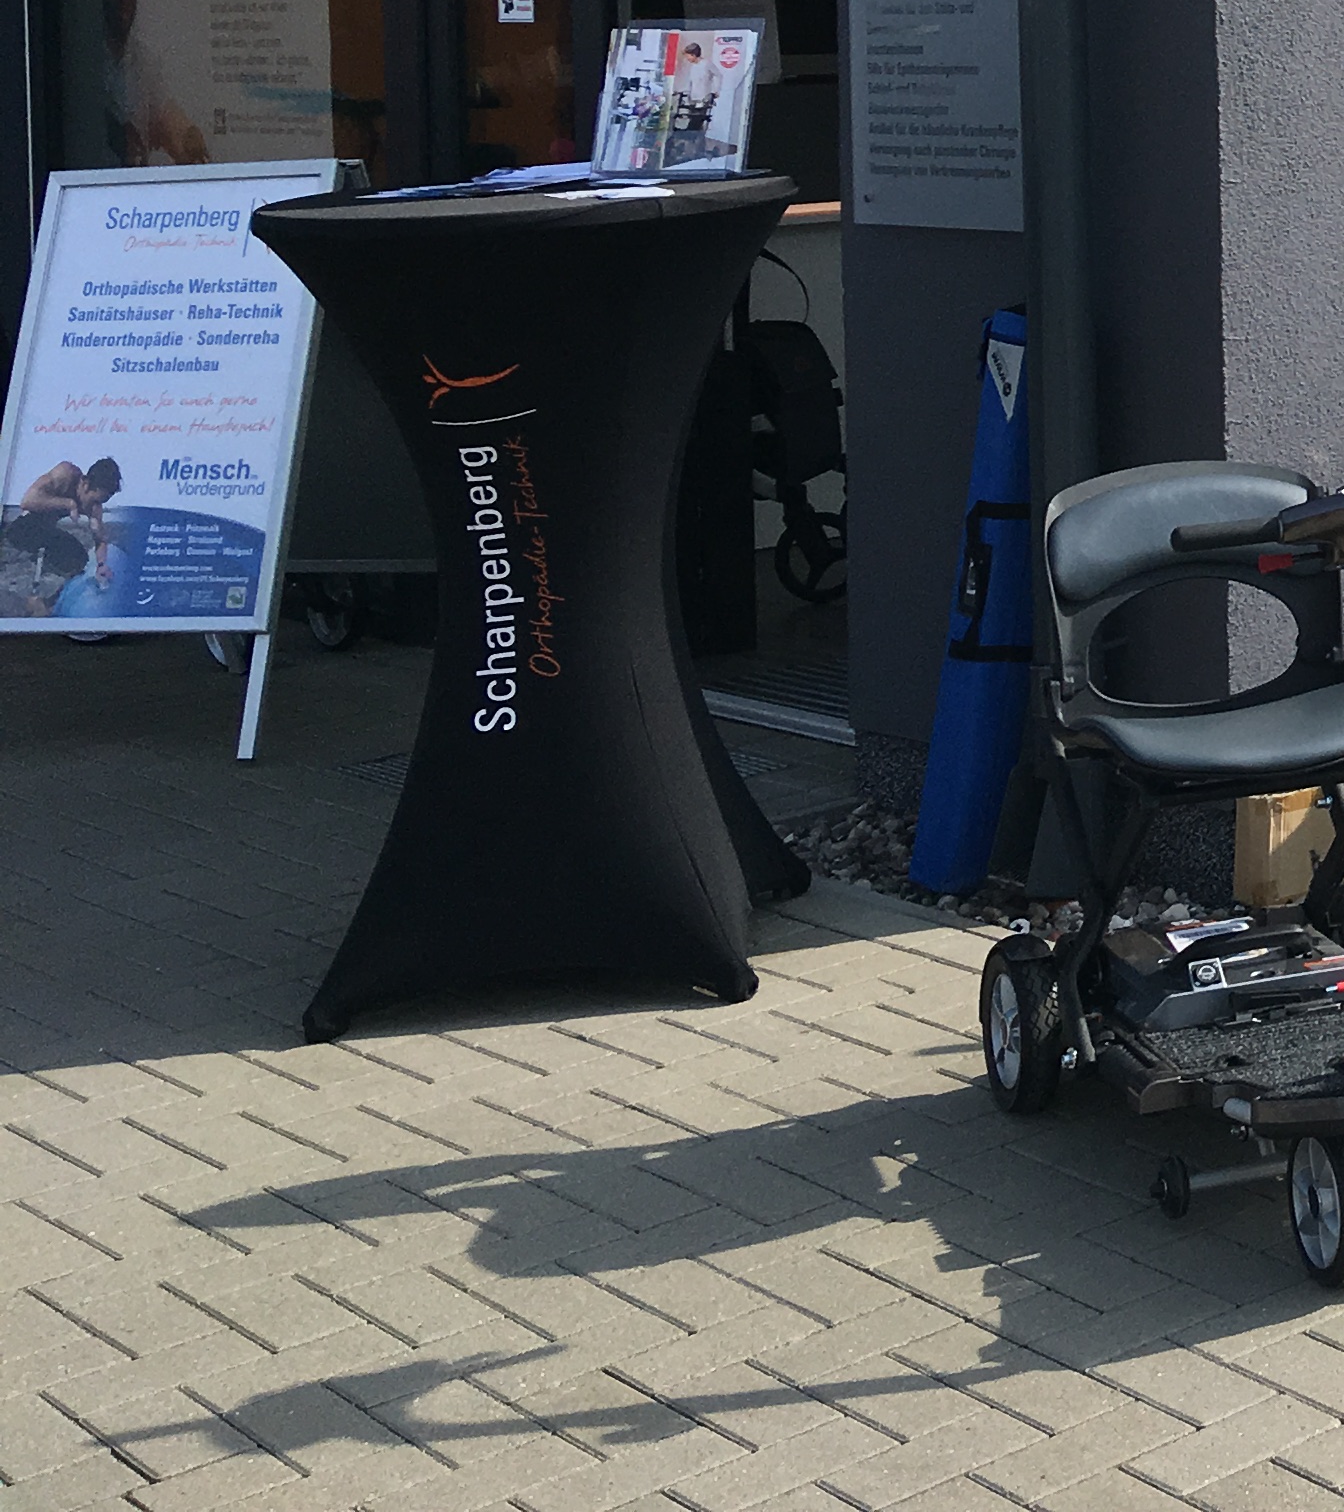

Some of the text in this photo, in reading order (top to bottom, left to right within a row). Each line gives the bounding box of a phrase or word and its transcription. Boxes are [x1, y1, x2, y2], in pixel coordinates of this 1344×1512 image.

[105, 205, 241, 233] Scharpenberg
[82, 278, 278, 299] Orthopädische Werkstätten
[67, 303, 284, 323] Sanitätshäuser Reha-Technik
[61, 330, 280, 350] Kinderorthopädie Sonderreha
[111, 357, 219, 373] Sitzschalenbau
[159, 457, 251, 481] Mensch
[176, 482, 265, 499] Vordergrund
[458, 445, 526, 733] Scharpenberg
